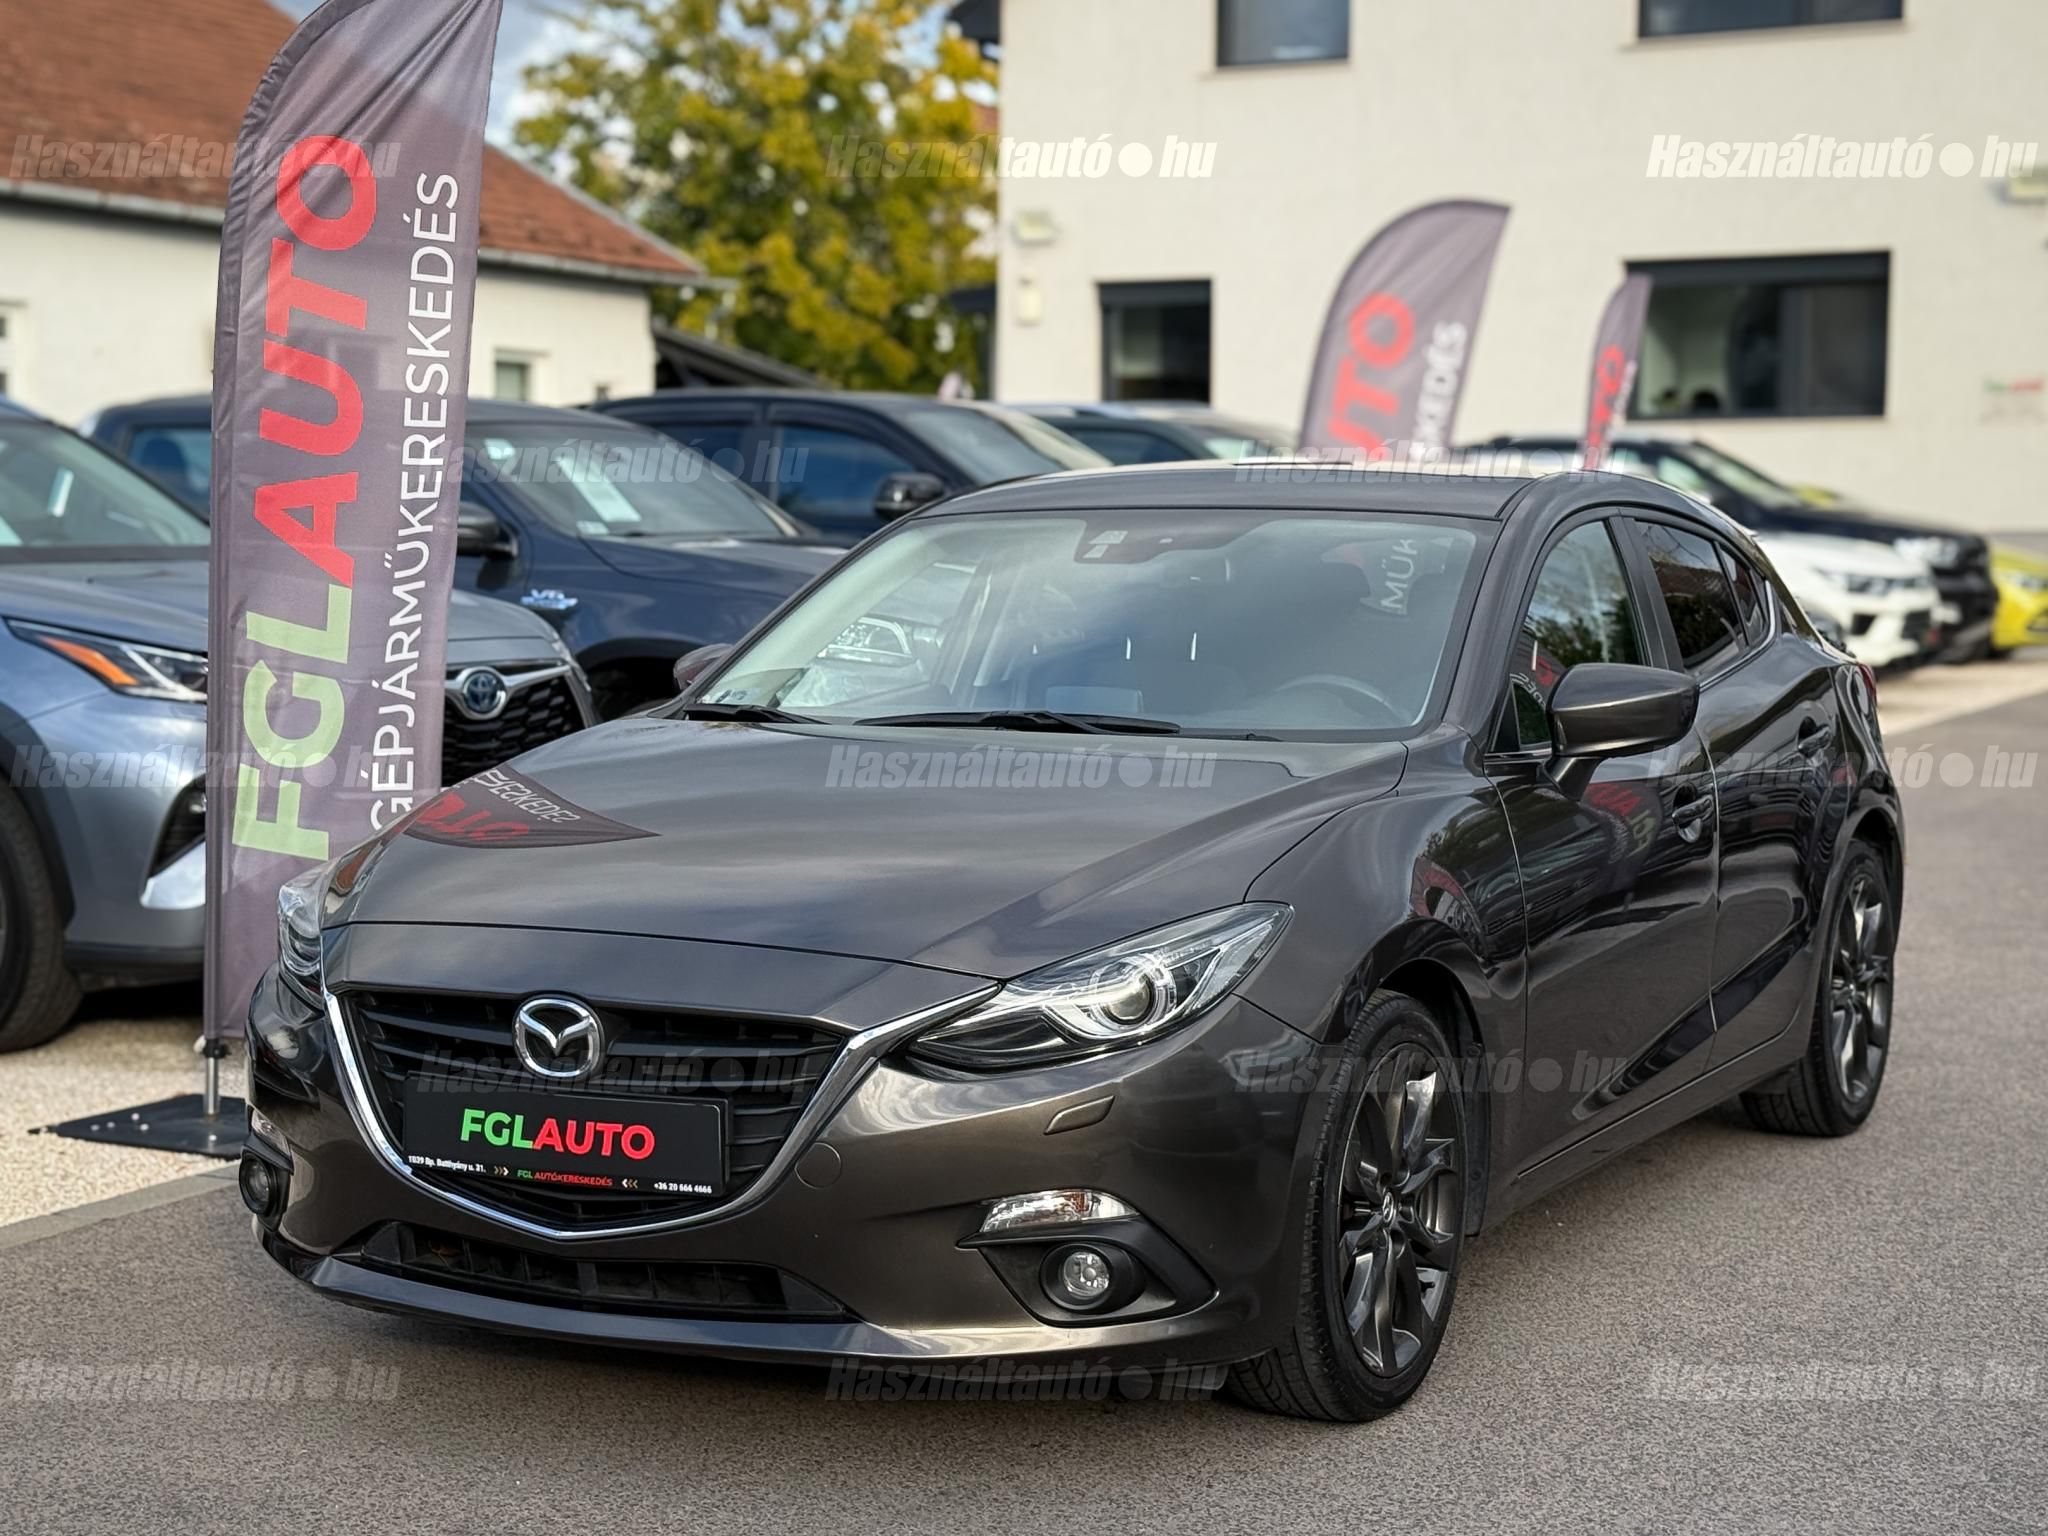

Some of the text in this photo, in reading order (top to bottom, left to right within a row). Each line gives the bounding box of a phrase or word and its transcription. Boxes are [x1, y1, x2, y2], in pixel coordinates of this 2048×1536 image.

[231, 134, 378, 861] FGLAUTO
[360, 172, 459, 830] GÉPJÁRMŰKERESKEDÉS
[460, 1108, 655, 1160] FGLAUTO
[517, 1169, 534, 1180] FGL
